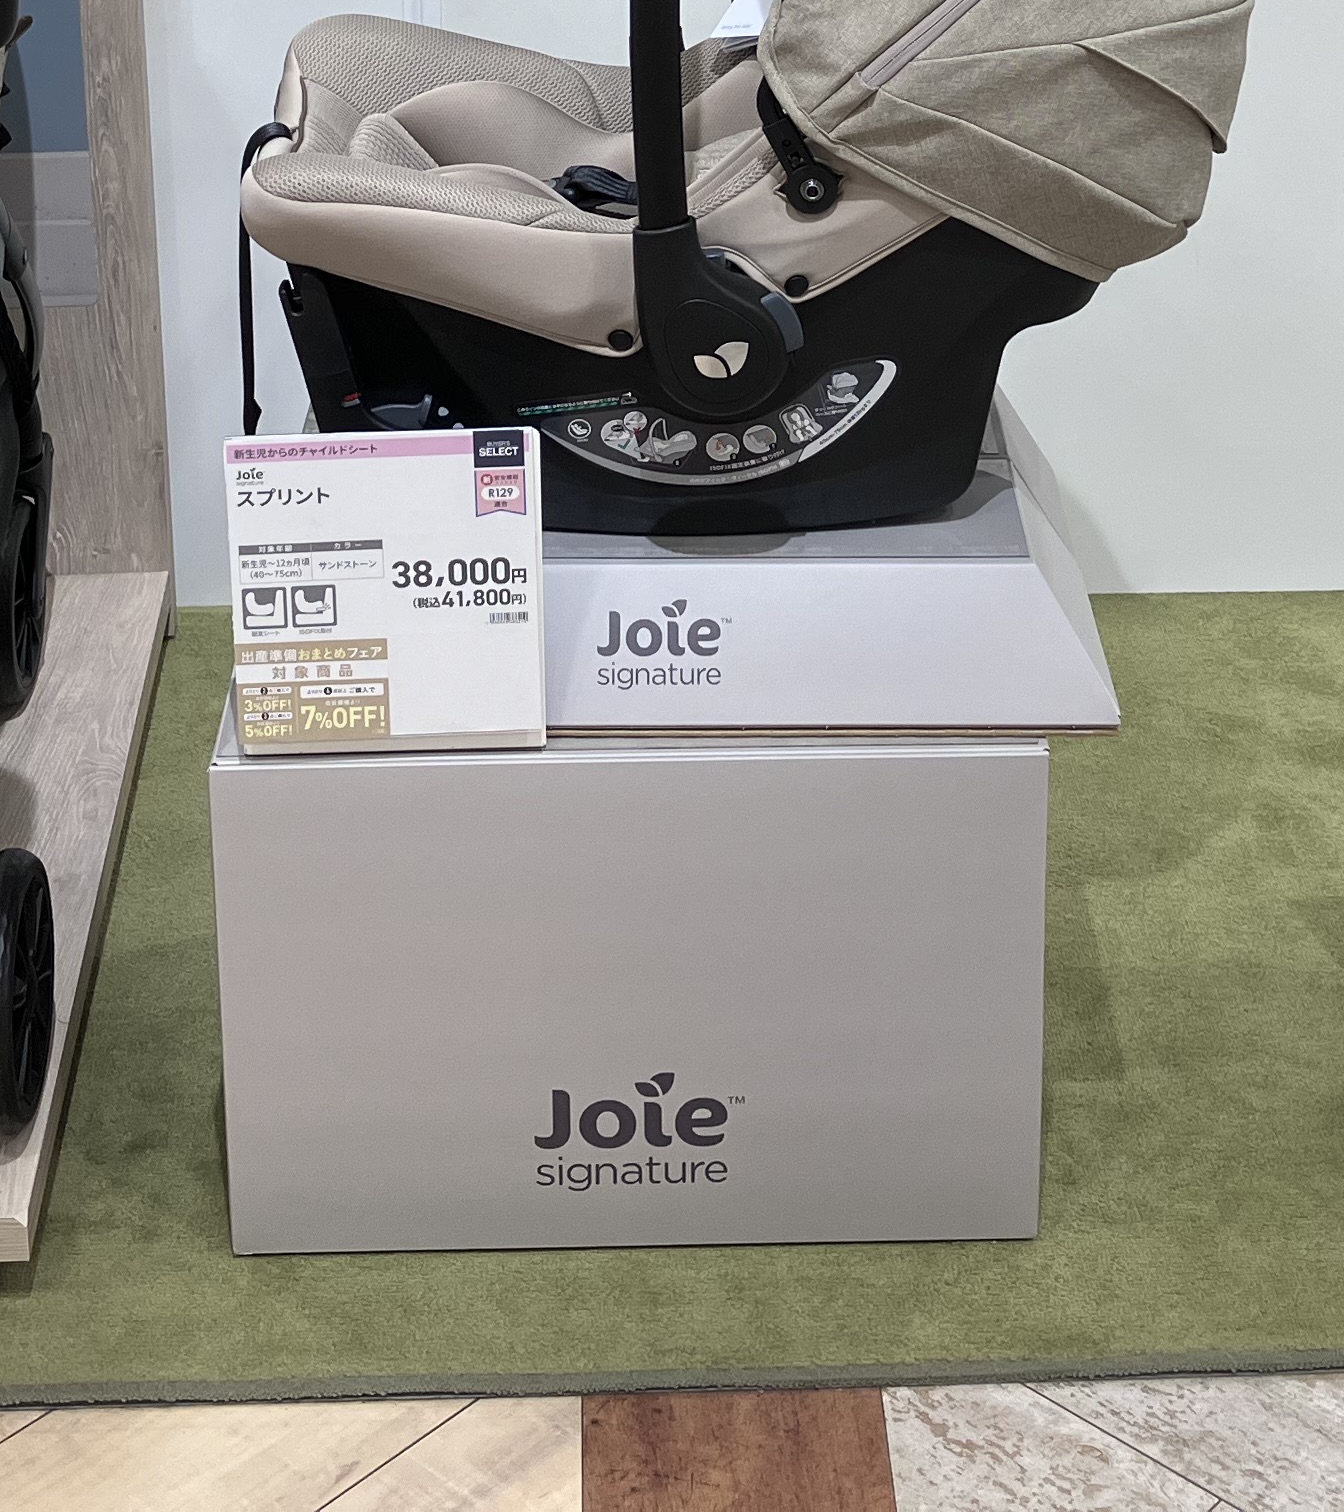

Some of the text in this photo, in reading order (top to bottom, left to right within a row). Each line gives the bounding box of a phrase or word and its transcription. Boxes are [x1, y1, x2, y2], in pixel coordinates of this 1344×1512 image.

[233, 443, 378, 460] 新生児からのチャイルドシート
[478, 446, 519, 457] SELECT
[236, 467, 264, 480] Joie
[236, 486, 331, 507] スプリント
[488, 487, 514, 498] R129
[318, 560, 378, 570] サンドストーン
[391, 556, 527, 589] 38,000円
[596, 598, 722, 657] Joie
[241, 646, 382, 663] 出産準備おまとめフェア
[597, 661, 722, 690] signature
[244, 699, 292, 713] 3%OFF!
[300, 705, 386, 730] 7%OFF!
[245, 724, 293, 738] 5%OFF!
[534, 1071, 728, 1149] Joie
[536, 1156, 728, 1192] signature
